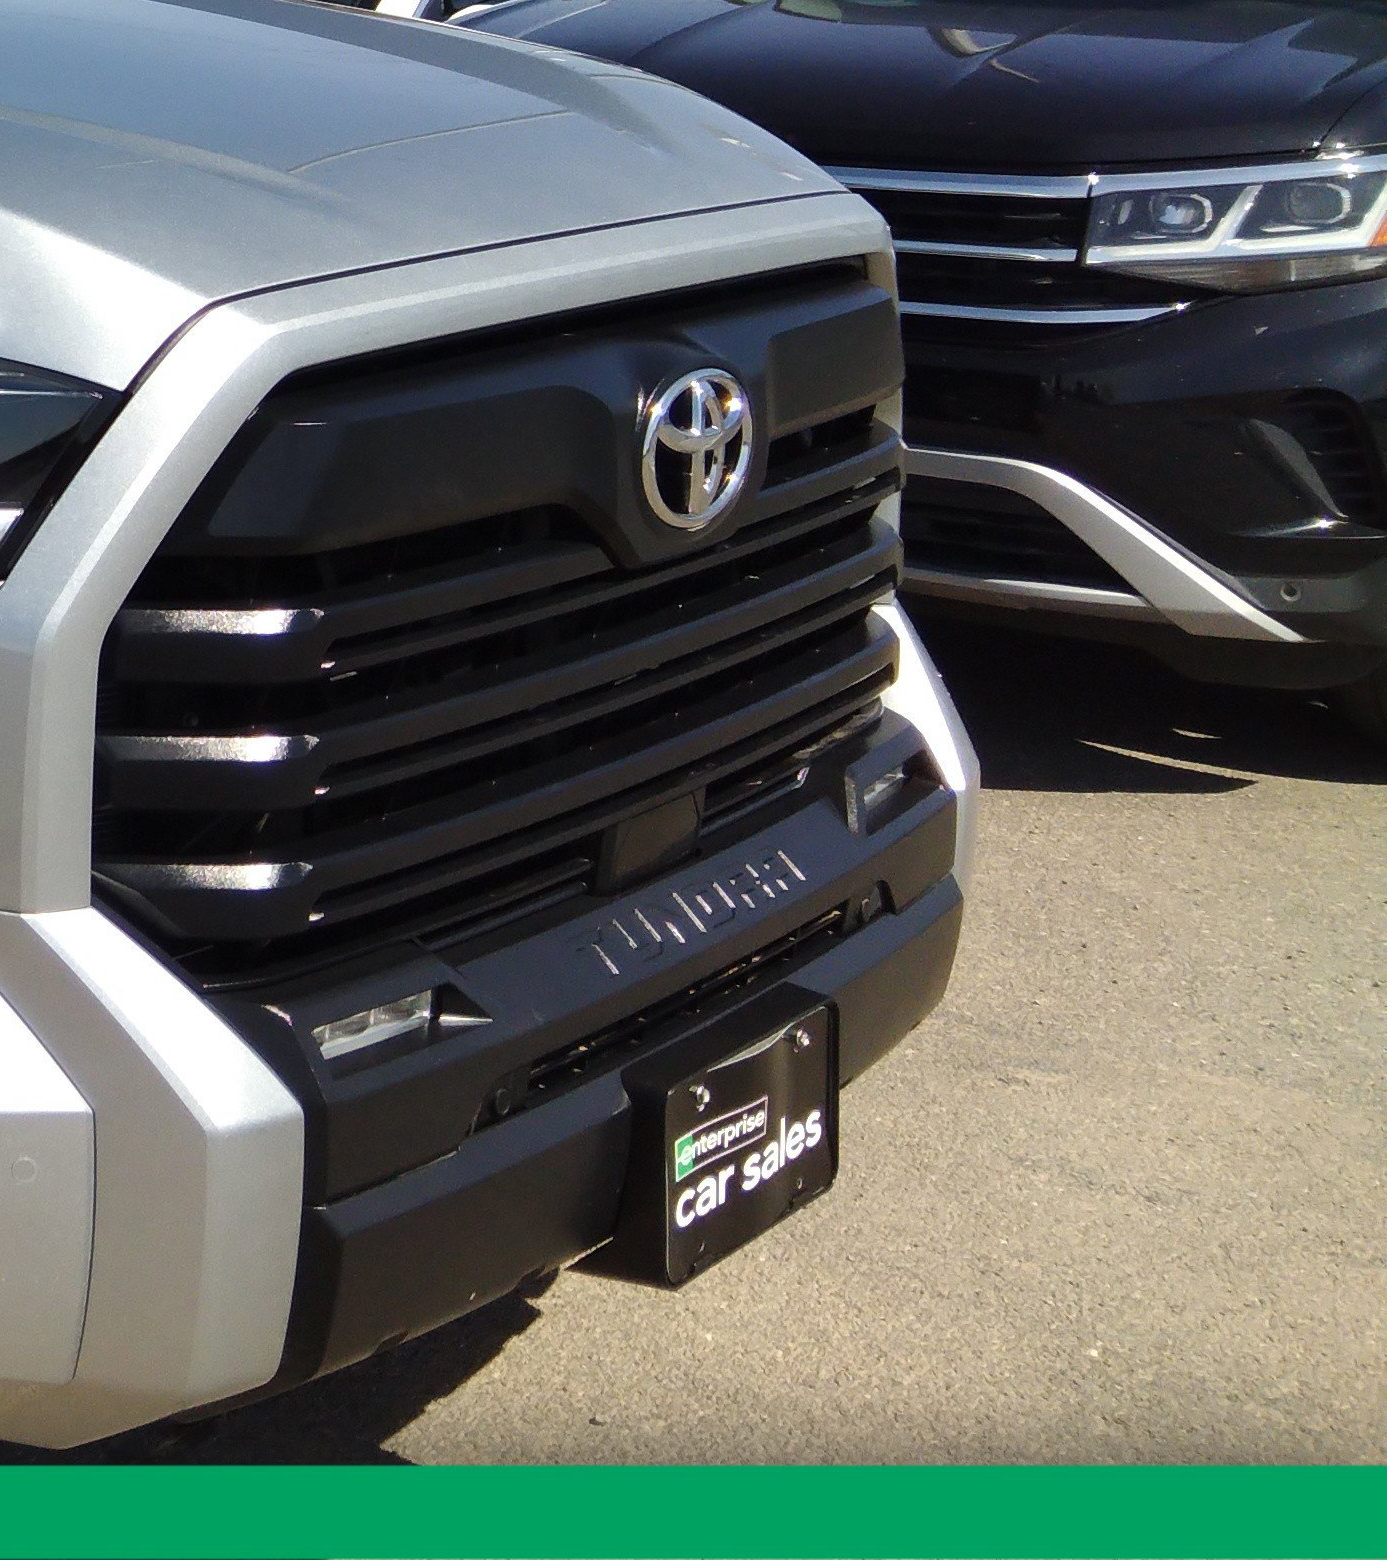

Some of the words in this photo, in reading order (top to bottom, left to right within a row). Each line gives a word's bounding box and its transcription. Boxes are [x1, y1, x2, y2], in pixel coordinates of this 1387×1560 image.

[577, 848, 807, 976] TUNDRA
[676, 1162, 736, 1229] car
[741, 1109, 822, 1192] sales
[677, 1108, 766, 1167] enterprise
